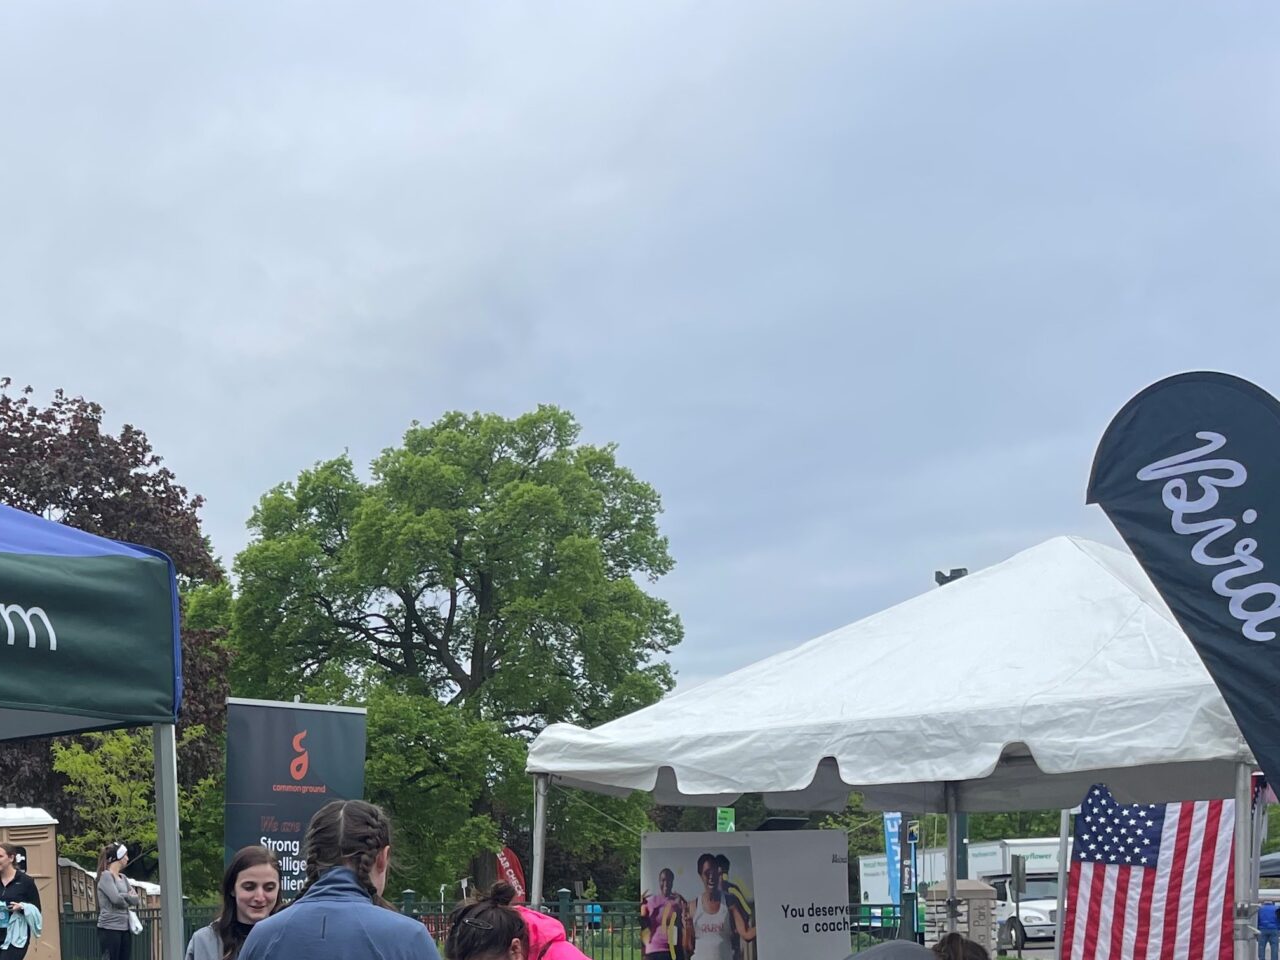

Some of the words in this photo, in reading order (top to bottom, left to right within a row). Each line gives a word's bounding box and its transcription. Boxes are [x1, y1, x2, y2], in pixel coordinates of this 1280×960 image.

[260, 836, 300, 855] Strong
[506, 869, 526, 896] CHECK
[781, 904, 805, 918] You
[973, 905, 986, 927] Park
[802, 922, 809, 933] a
[814, 917, 849, 933] coach
